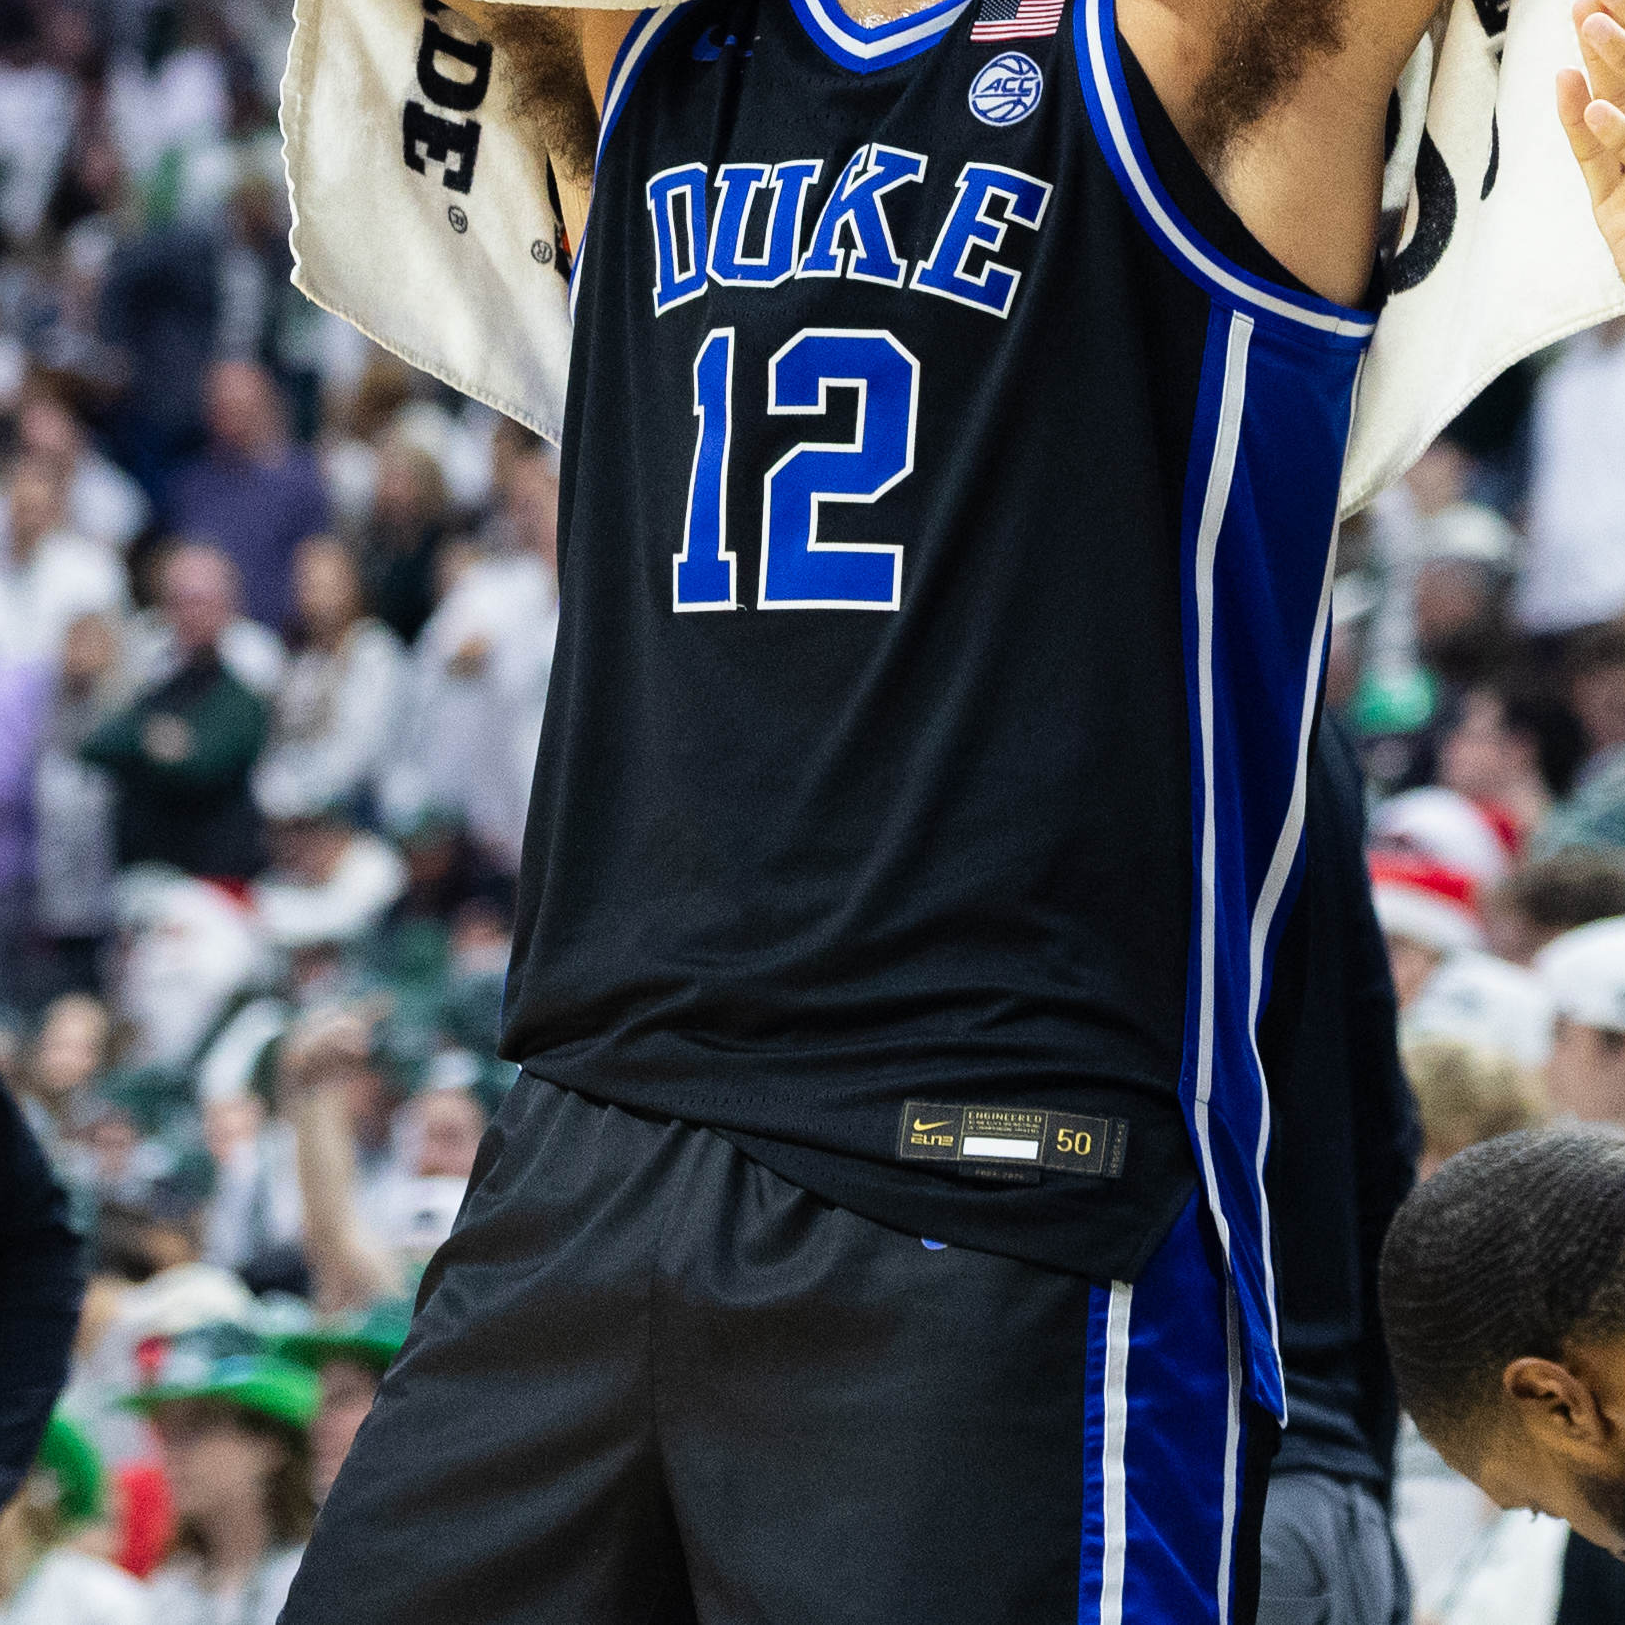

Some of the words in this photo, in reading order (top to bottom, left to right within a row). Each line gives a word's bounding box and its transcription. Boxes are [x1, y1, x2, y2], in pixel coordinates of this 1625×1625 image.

[980, 75, 1039, 94] ACC
[645, 143, 1054, 319] DUKE
[672, 326, 922, 612] 12
[1056, 1127, 1092, 1155] 50
